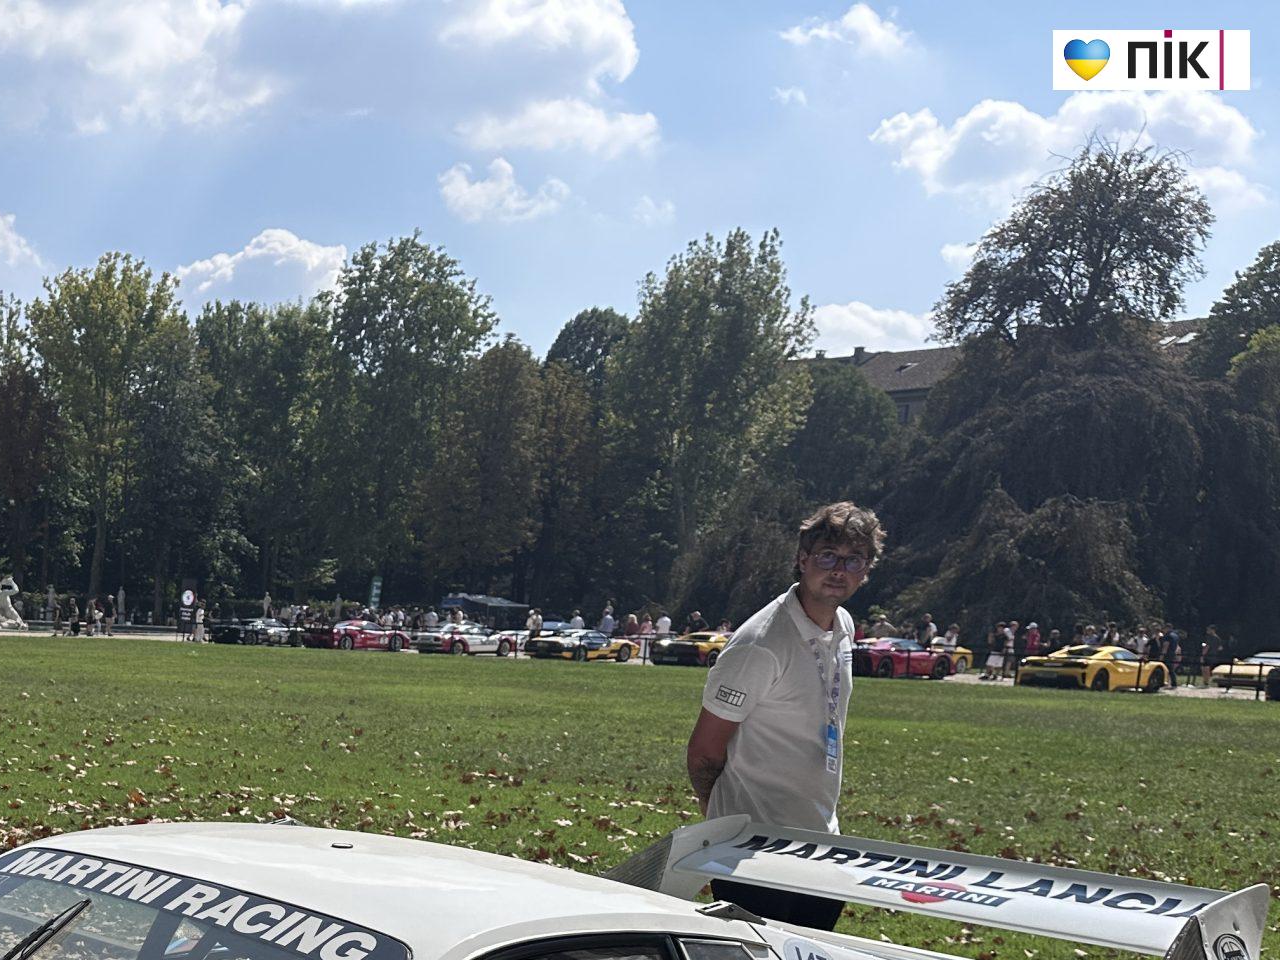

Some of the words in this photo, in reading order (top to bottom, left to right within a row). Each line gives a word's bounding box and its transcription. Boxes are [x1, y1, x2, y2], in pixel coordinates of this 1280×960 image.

[0, 851, 184, 903] MARTINI
[734, 835, 967, 880] MARTINI
[872, 878, 1002, 905] MARTINI
